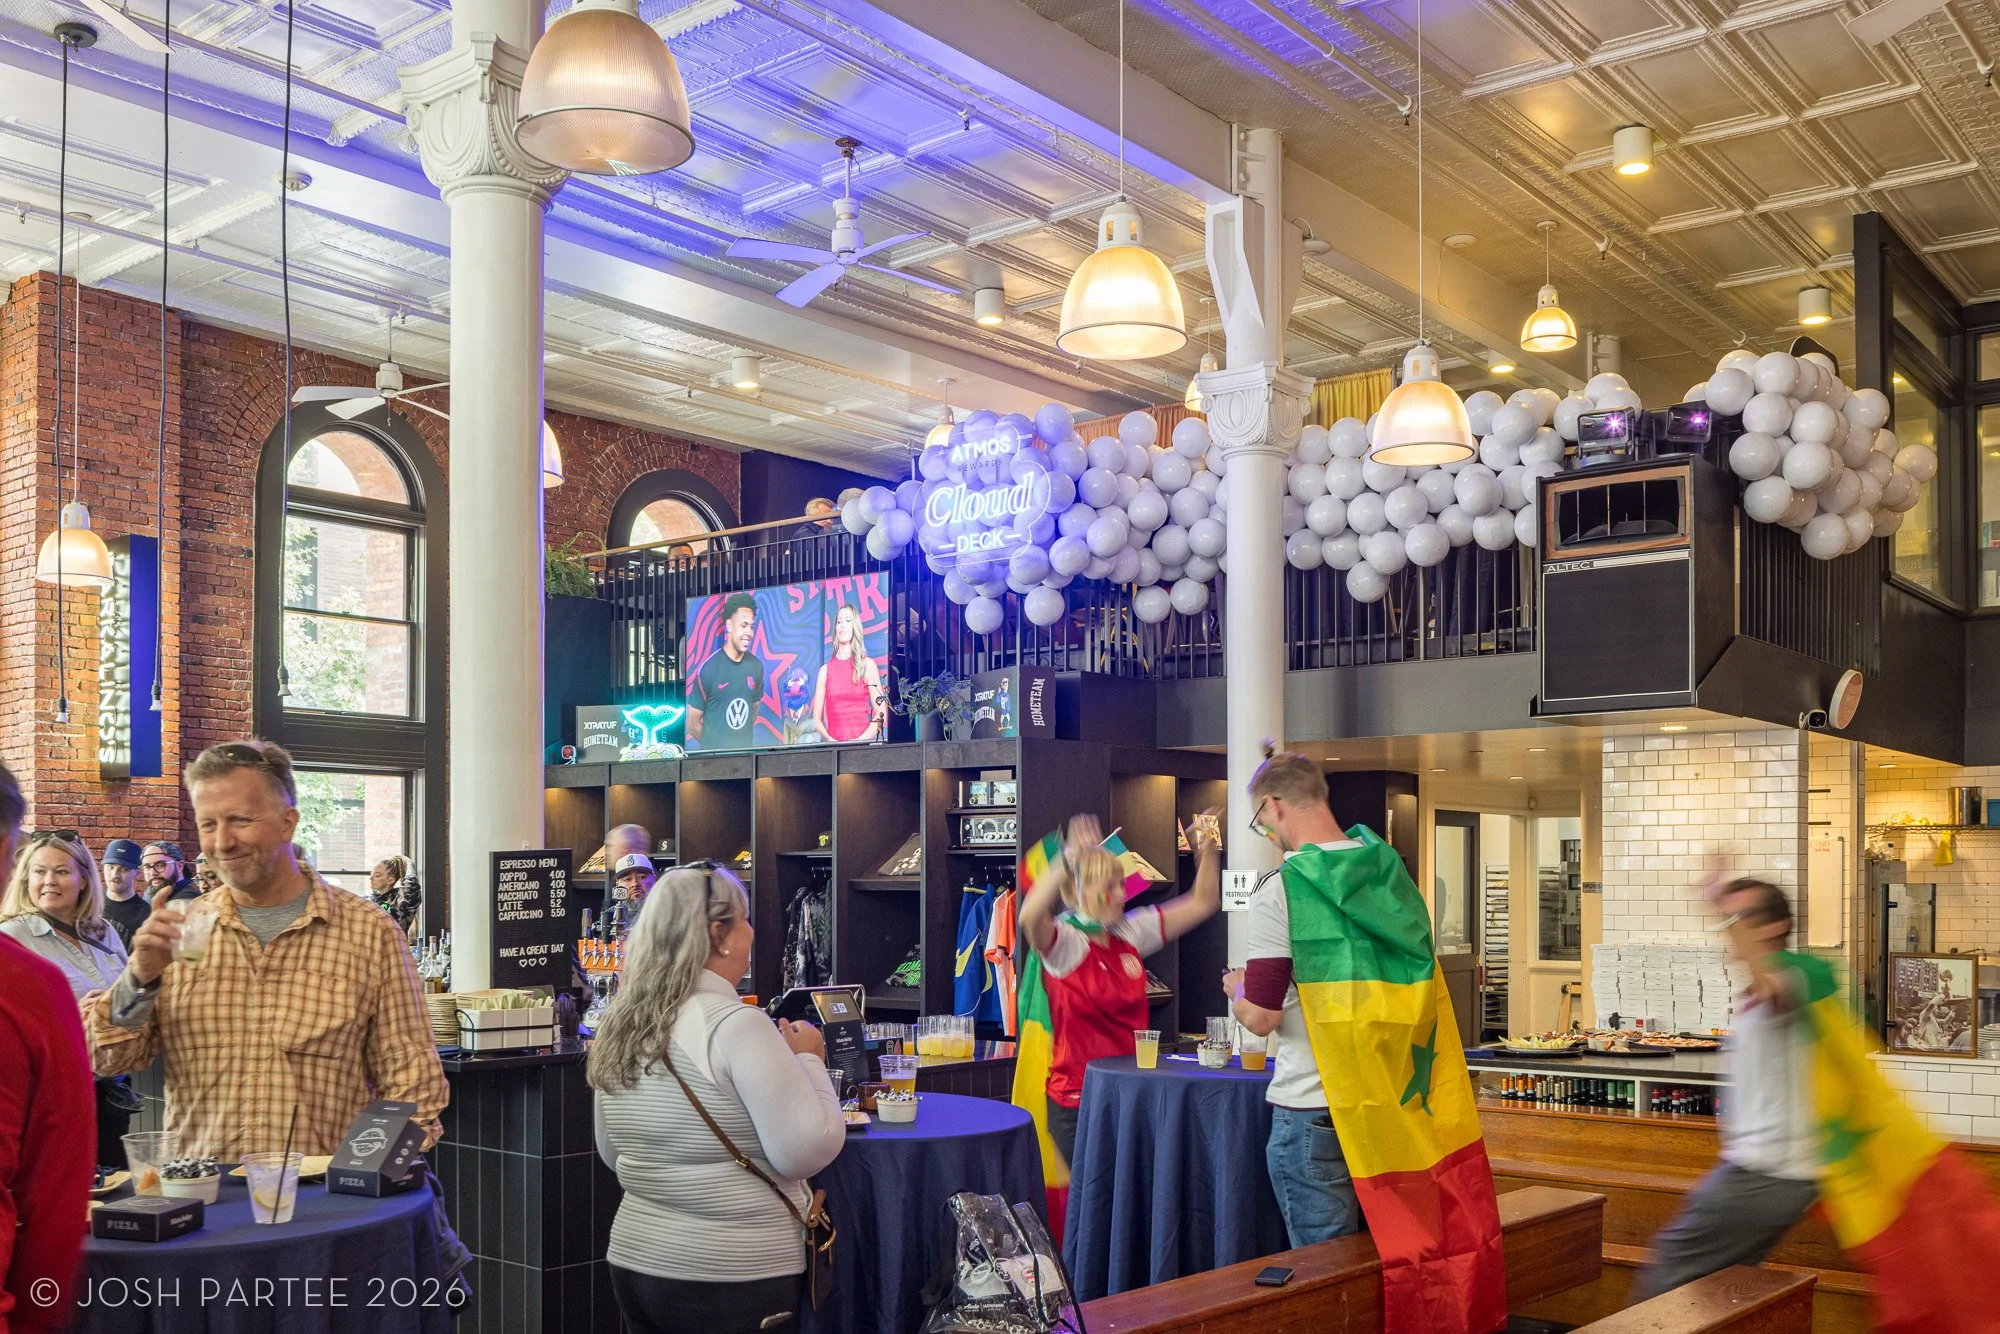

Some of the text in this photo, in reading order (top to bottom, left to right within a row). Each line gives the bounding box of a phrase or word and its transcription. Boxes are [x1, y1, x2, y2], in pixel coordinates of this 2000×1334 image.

[951, 436, 1011, 462] ATMOS
[957, 459, 1004, 473] REWARDS
[925, 470, 1036, 528] Cloud
[956, 529, 1005, 553] DECK
[1546, 561, 1590, 573] ALTEC
[974, 689, 995, 702] XTRATUF
[1029, 678, 1046, 727] HOMETEAM
[583, 720, 618, 730] XTRATUF
[583, 733, 618, 748] HOMETEAM
[500, 858, 557, 869] ESPRESSO MENU
[500, 870, 565, 881] DOPPIO 4.00
[498, 881, 539, 891] AMERICANO
[498, 889, 566, 901] MACCHIATO 5.50
[498, 901, 524, 911] LATTE
[498, 908, 565, 921] CAPPUCCINO 5.50
[500, 943, 564, 957] HAVE A GREAT DAY
[339, 1176, 365, 1187] PIZZA
[106, 1219, 140, 1231] PIZZA
